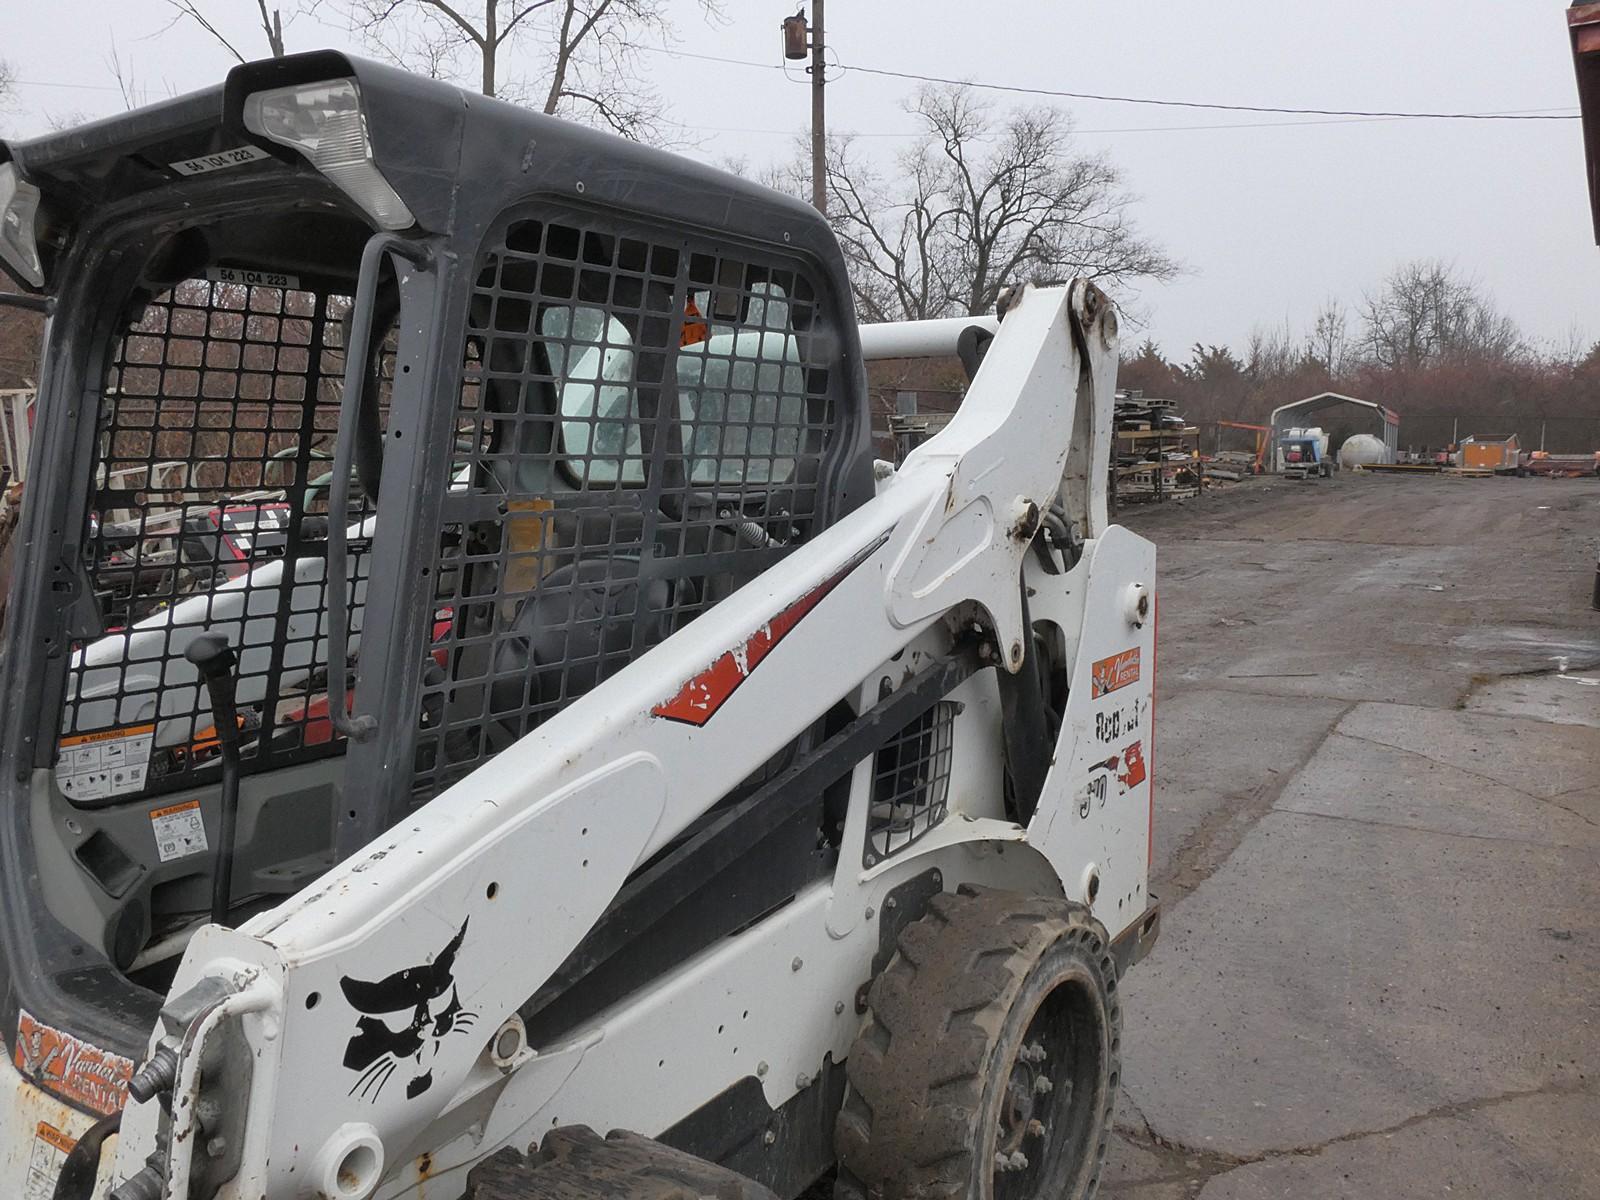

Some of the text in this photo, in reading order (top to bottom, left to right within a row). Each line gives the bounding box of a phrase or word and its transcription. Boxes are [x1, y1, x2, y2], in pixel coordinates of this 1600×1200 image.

[185, 149, 255, 172] 56 104 223
[220, 269, 288, 287] 56 104 223
